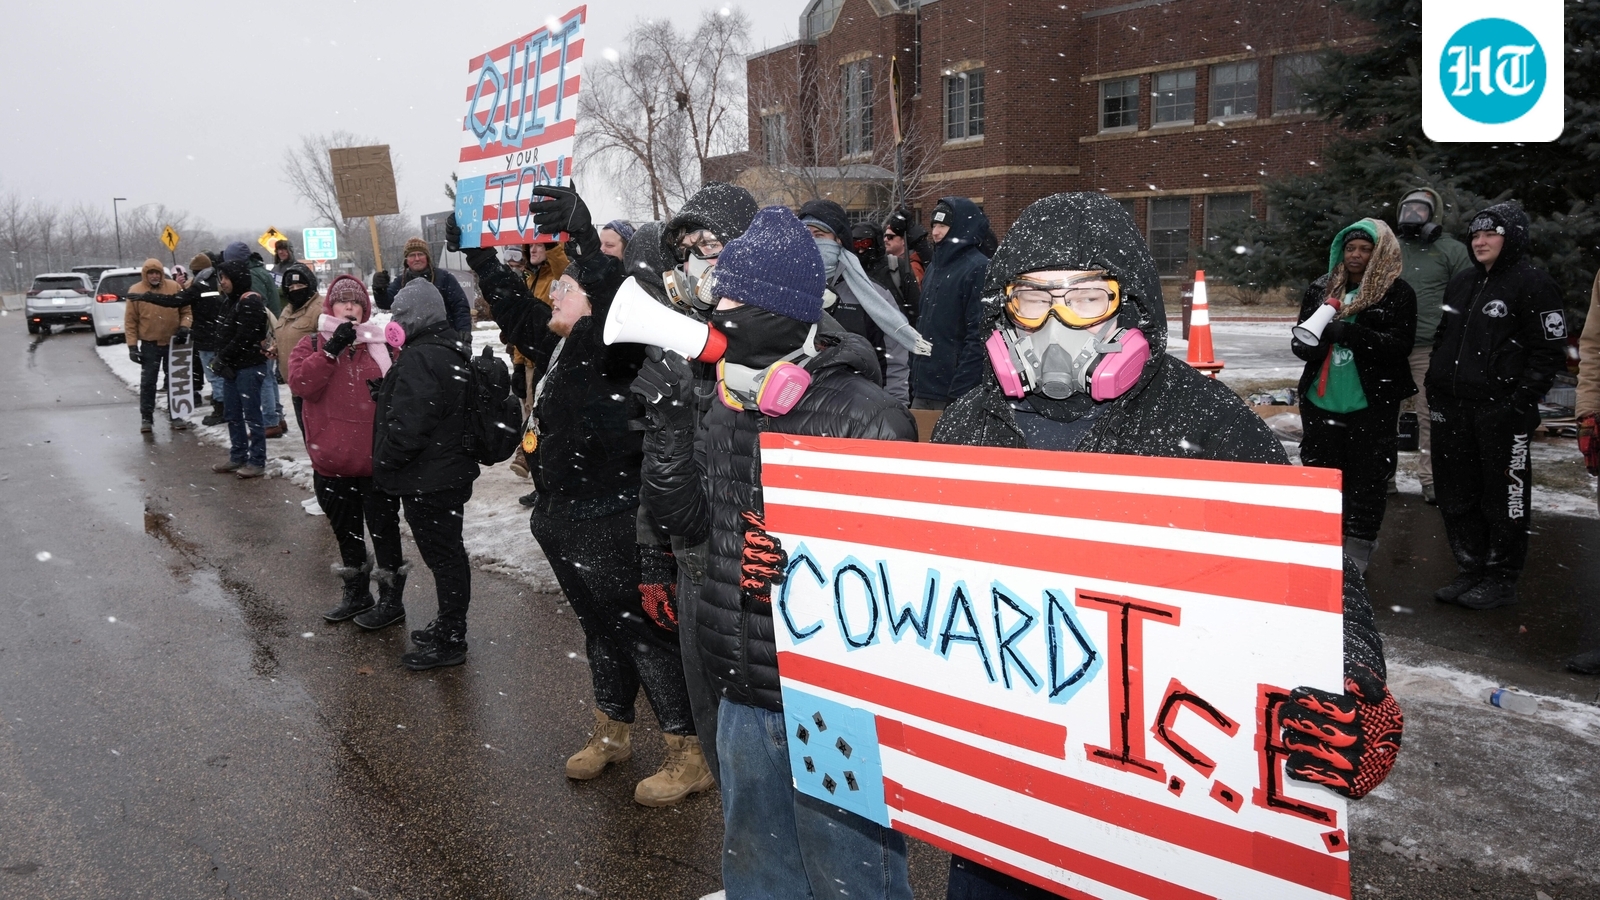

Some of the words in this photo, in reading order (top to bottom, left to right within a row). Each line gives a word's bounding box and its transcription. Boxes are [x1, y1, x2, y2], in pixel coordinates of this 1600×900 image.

[467, 15, 581, 148] QUIT
[333, 148, 369, 170] ICE
[505, 147, 539, 171] YOUR
[340, 191, 397, 212] THUGS
